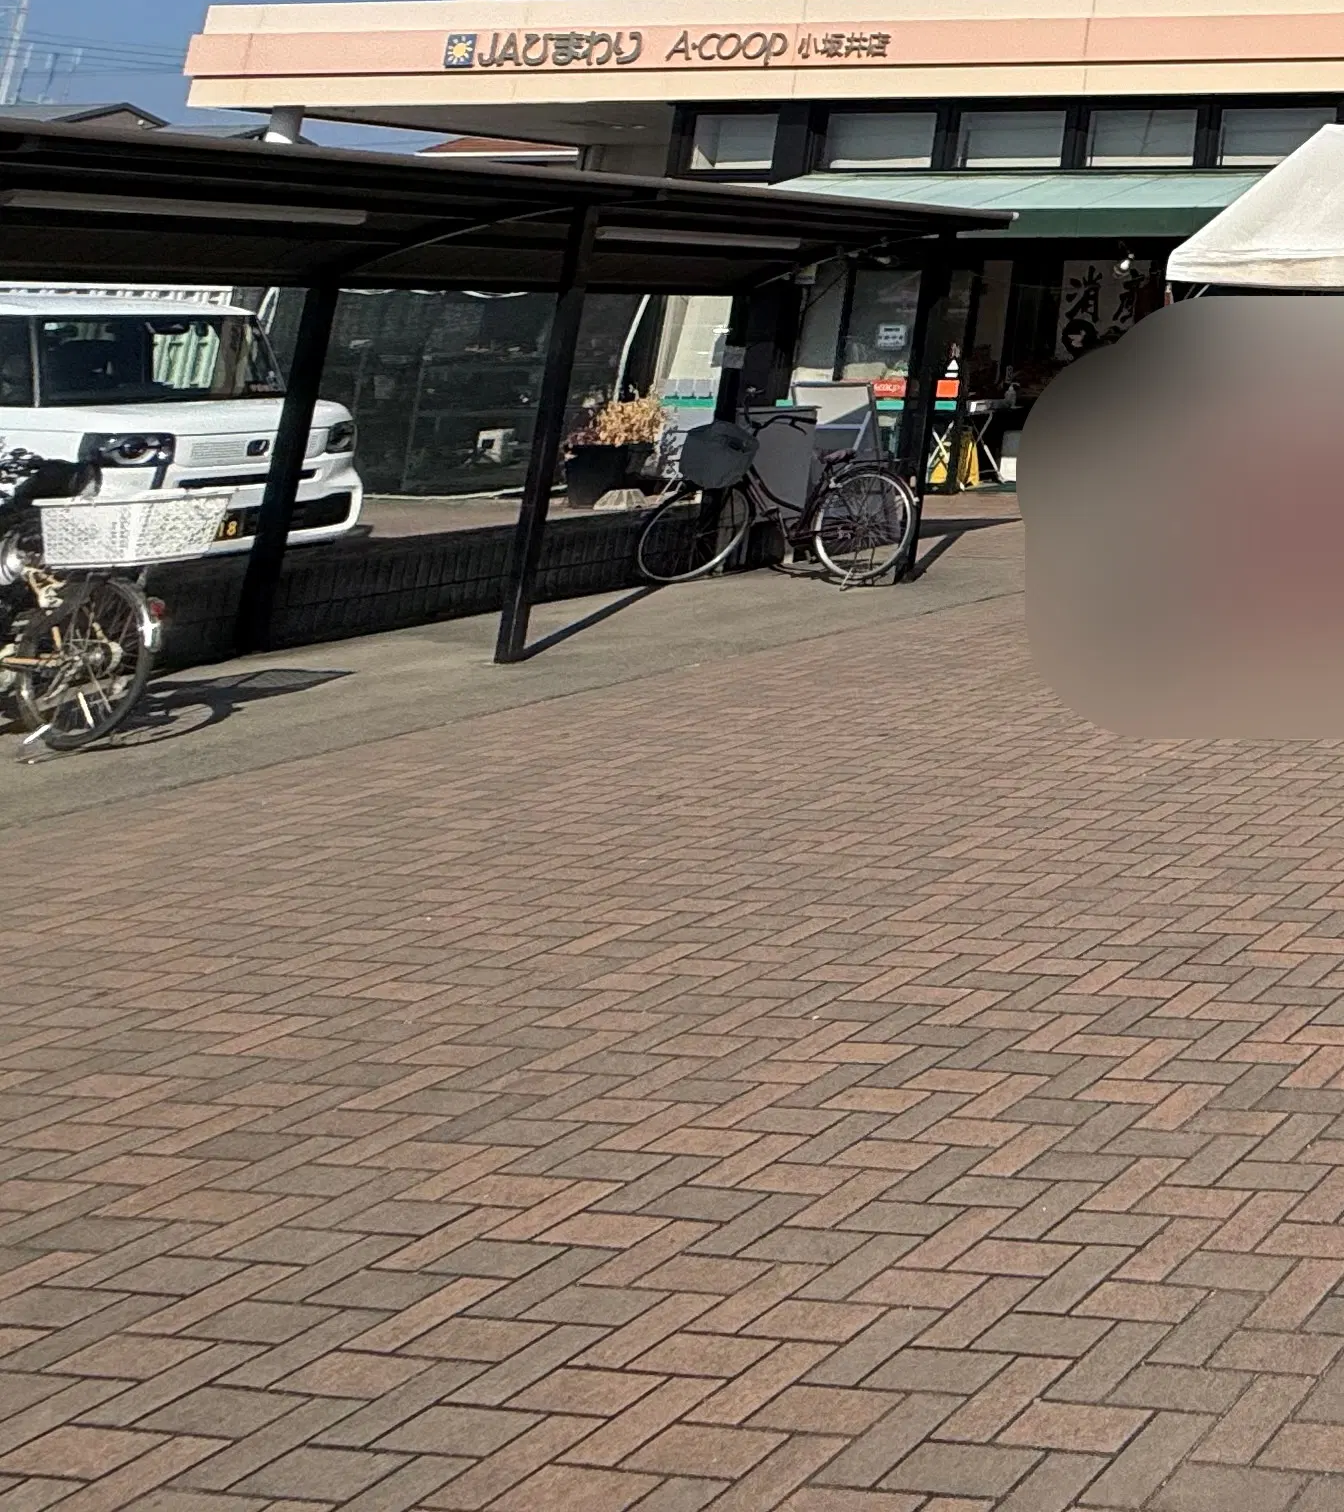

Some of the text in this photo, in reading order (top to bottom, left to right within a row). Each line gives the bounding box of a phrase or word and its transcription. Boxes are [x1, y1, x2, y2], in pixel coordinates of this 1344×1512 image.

[477, 30, 643, 67] JAひまわり
[797, 32, 892, 59] 小坂井店
